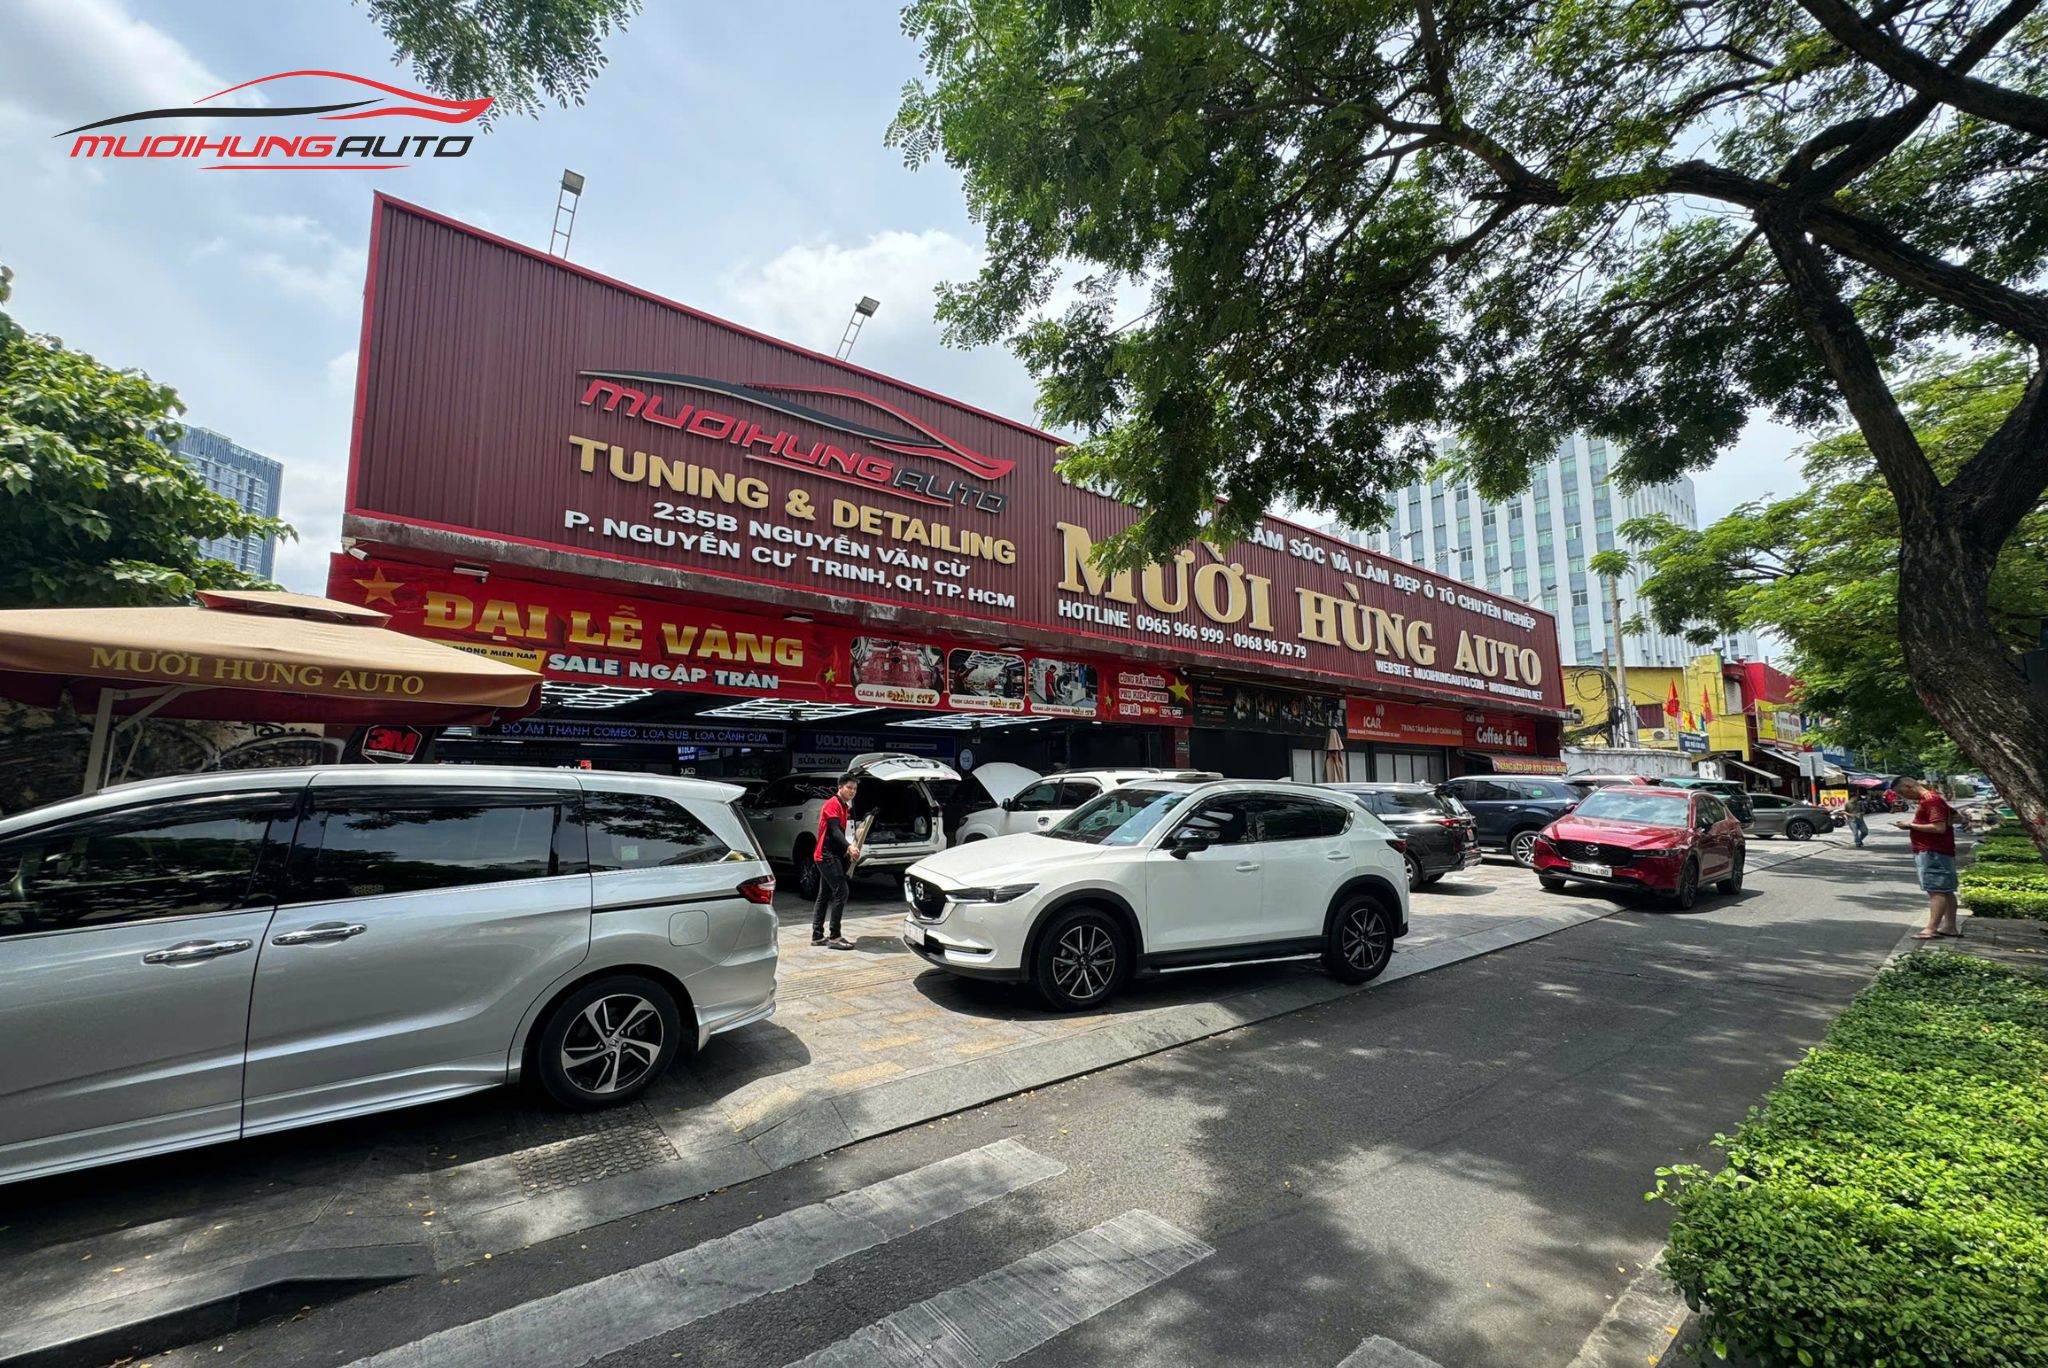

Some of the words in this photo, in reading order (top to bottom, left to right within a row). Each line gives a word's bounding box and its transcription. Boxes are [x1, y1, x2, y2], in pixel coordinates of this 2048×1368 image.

[569, 434, 769, 509] TUNING
[785, 488, 816, 521] &
[832, 498, 1017, 565] DETAILING
[564, 510, 595, 532] P.
[603, 518, 740, 559] NGUYỄN
[751, 546, 797, 567] CƯ
[653, 502, 738, 531] 235B
[749, 519, 870, 559] NGUYỄN
[876, 547, 929, 571] VĂN
[933, 559, 971, 578] CỪ
[1288, 536, 1326, 564] SÓC
[1329, 550, 1352, 573] VÀ
[1355, 559, 1390, 585] LÀM
[1392, 573, 1421, 595] ĐẸP
[1423, 579, 1435, 599] Ô
[1437, 587, 1456, 605] TÔ
[1457, 594, 1501, 620] CHUYÊN
[1502, 608, 1536, 632] NGHIỆP
[1056, 521, 1274, 632] MƯỜI
[1295, 581, 1436, 666] HÙNG
[1454, 630, 1542, 686] AUTO
[423, 591, 549, 641] ĐẠI
[569, 605, 643, 650] LỄ
[661, 622, 803, 667] VÀNG
[1136, 614, 1171, 635] 0965
[1174, 622, 1198, 640] 966
[1200, 627, 1224, 644] 999
[1233, 633, 1262, 651] 0968
[517, 652, 537, 661] NAM
[548, 653, 620, 676] SALE
[629, 662, 707, 685] NGẬP
[715, 669, 778, 690] TRÀN
[333, 669, 425, 695] AUTO
[368, 728, 418, 753] 3M
[548, 725, 590, 736] THANH
[643, 729, 666, 739] LOA
[695, 731, 715, 740] LOA
[1363, 715, 1382, 729] ICAR
[1476, 726, 1503, 744] Coffee
[1505, 729, 1512, 746] &
[1513, 730, 1527, 747] Tea
[816, 734, 875, 748] VOLTRONIC
